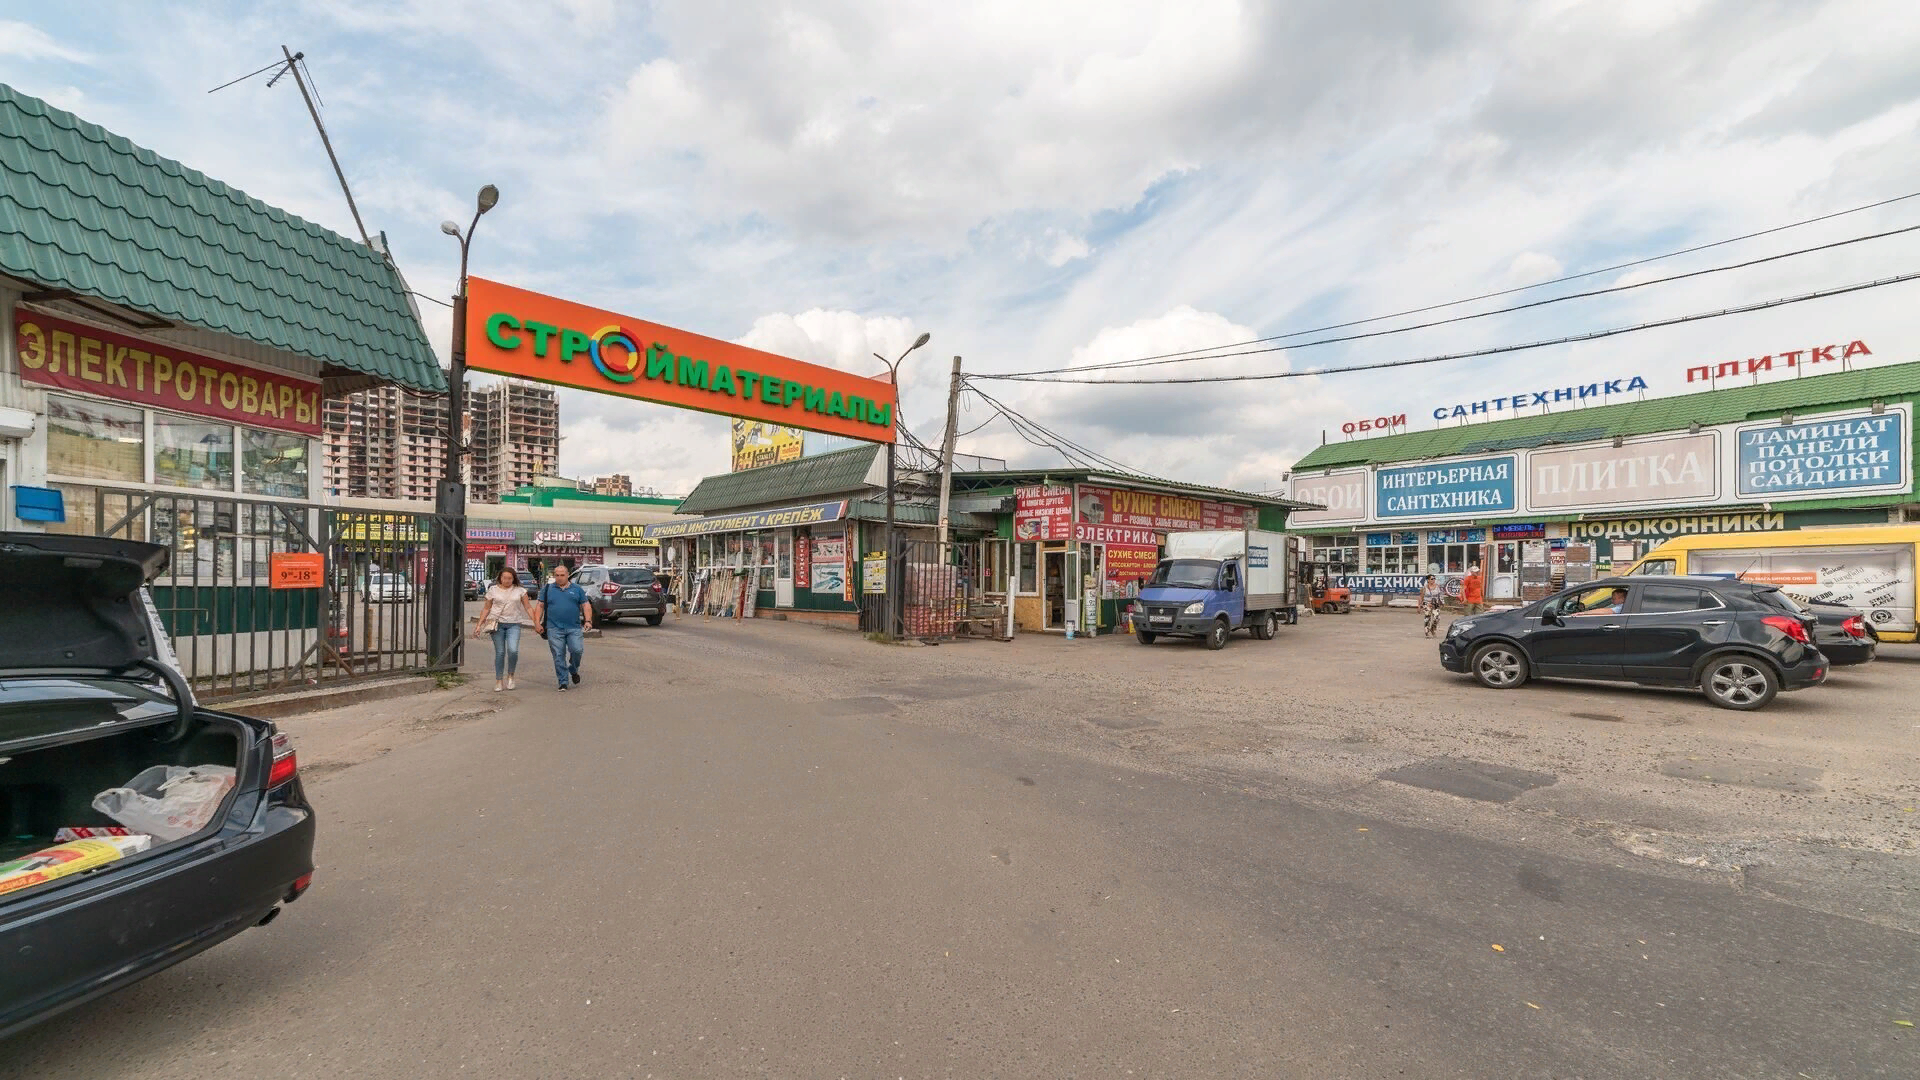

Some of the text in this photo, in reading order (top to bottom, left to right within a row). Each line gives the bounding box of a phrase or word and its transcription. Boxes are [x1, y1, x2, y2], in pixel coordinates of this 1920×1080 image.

[18, 322, 318, 425] ЭЛЕКТРОТОВАРЫ
[486, 312, 891, 427] СТРОЙМАТЕРИАЛЫ
[1686, 340, 1872, 383] ПЛИТКА
[1433, 375, 1648, 420] САНТЕХНИКА
[1342, 413, 1406, 433] ОБОИ
[1746, 418, 1892, 446] ЛАМИНАТ
[1759, 435, 1879, 459] ПАНЕЛИ
[1537, 451, 1705, 495] ПЛИТКА
[1749, 449, 1890, 473] ПОТОЛКИ
[1383, 463, 1508, 489] ИНТЕРЬЕРНАЯ
[1750, 465, 1889, 488] САЙДИНГ
[1016, 485, 1071, 499] СУХИЕ СМЕСИ
[1297, 481, 1363, 511] ОБОИ
[1387, 489, 1503, 512] САНТЕХНИКА
[1112, 491, 1201, 520] СУХИЕ СМЕСИ
[652, 507, 825, 537] РУЧНОЙ ИНСТРУМЕНТ КРЕПЁЖ
[1572, 512, 1785, 537] ПОДОКОННИКИ
[533, 531, 583, 541] КРЕПЕЖ
[1076, 526, 1157, 544] ЭЛЕКТРИКА
[517, 545, 602, 553] ИНСТРУМЕНТ
[1108, 550, 1157, 560] СУХИЕ СМЕСИ
[1338, 576, 1426, 588] САНТЕХНИК
